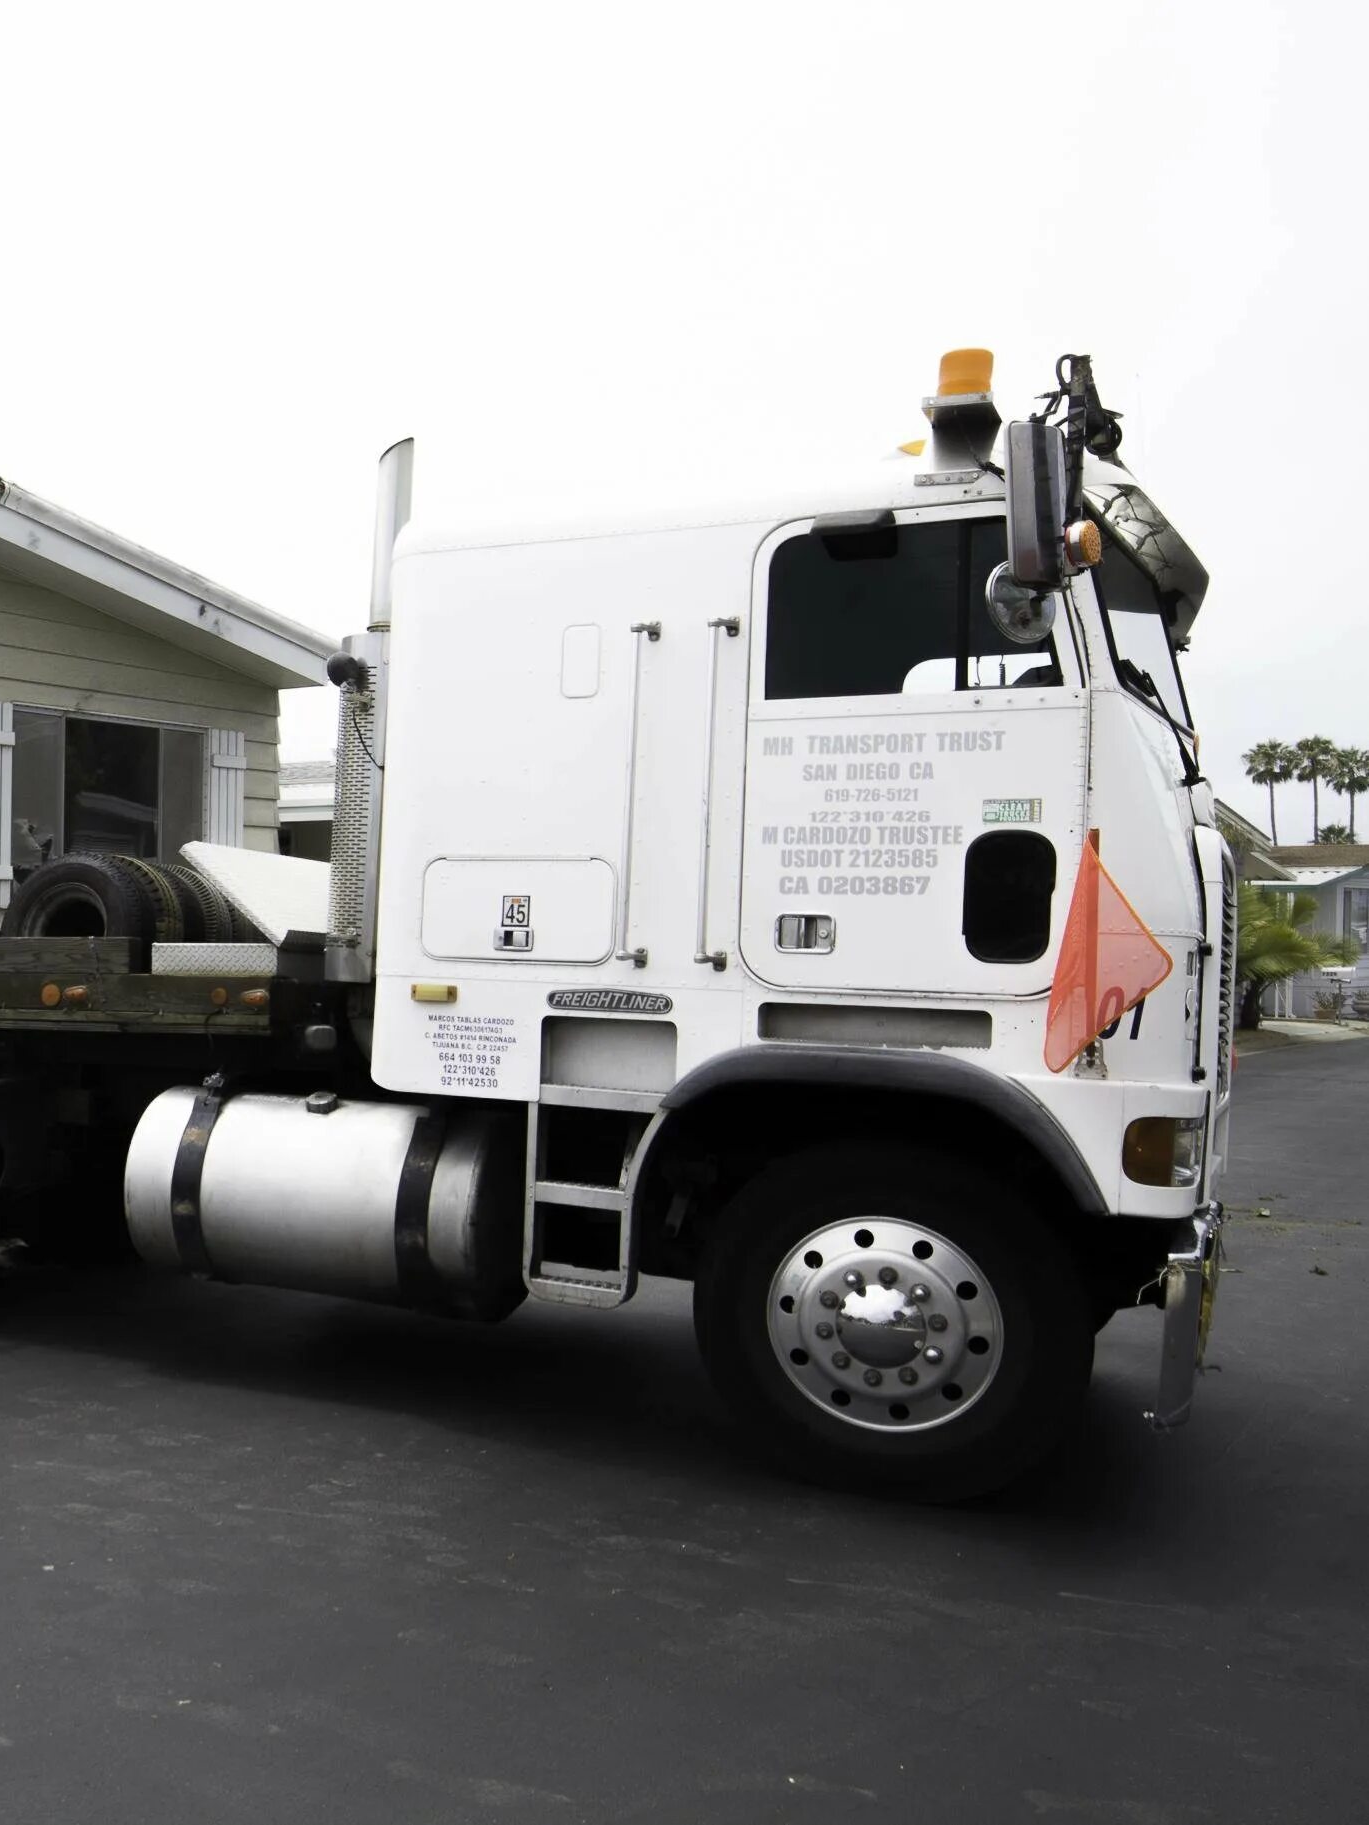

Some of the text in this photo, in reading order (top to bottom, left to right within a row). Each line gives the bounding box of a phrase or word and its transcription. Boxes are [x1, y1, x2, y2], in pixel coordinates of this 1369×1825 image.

[763, 730, 1006, 756] MH TRANSPORT TRUST
[802, 761, 934, 782] SAN DIEGO CA
[824, 788, 919, 803] 619-726-5121
[762, 826, 963, 845] M CARDOZO TRUSTEE
[780, 849, 938, 868] USDOT 2123585
[779, 876, 931, 895] CA 0203867
[506, 904, 526, 924] 45
[552, 991, 667, 1011] FREIGHTLINER
[457, 1016, 481, 1024] TABLAS
[483, 1018, 514, 1026] CARDOZO
[432, 1041, 459, 1049] TIJUANA
[478, 1035, 517, 1044] RINCONADA
[439, 1052, 501, 1065] 664 103 99 58
